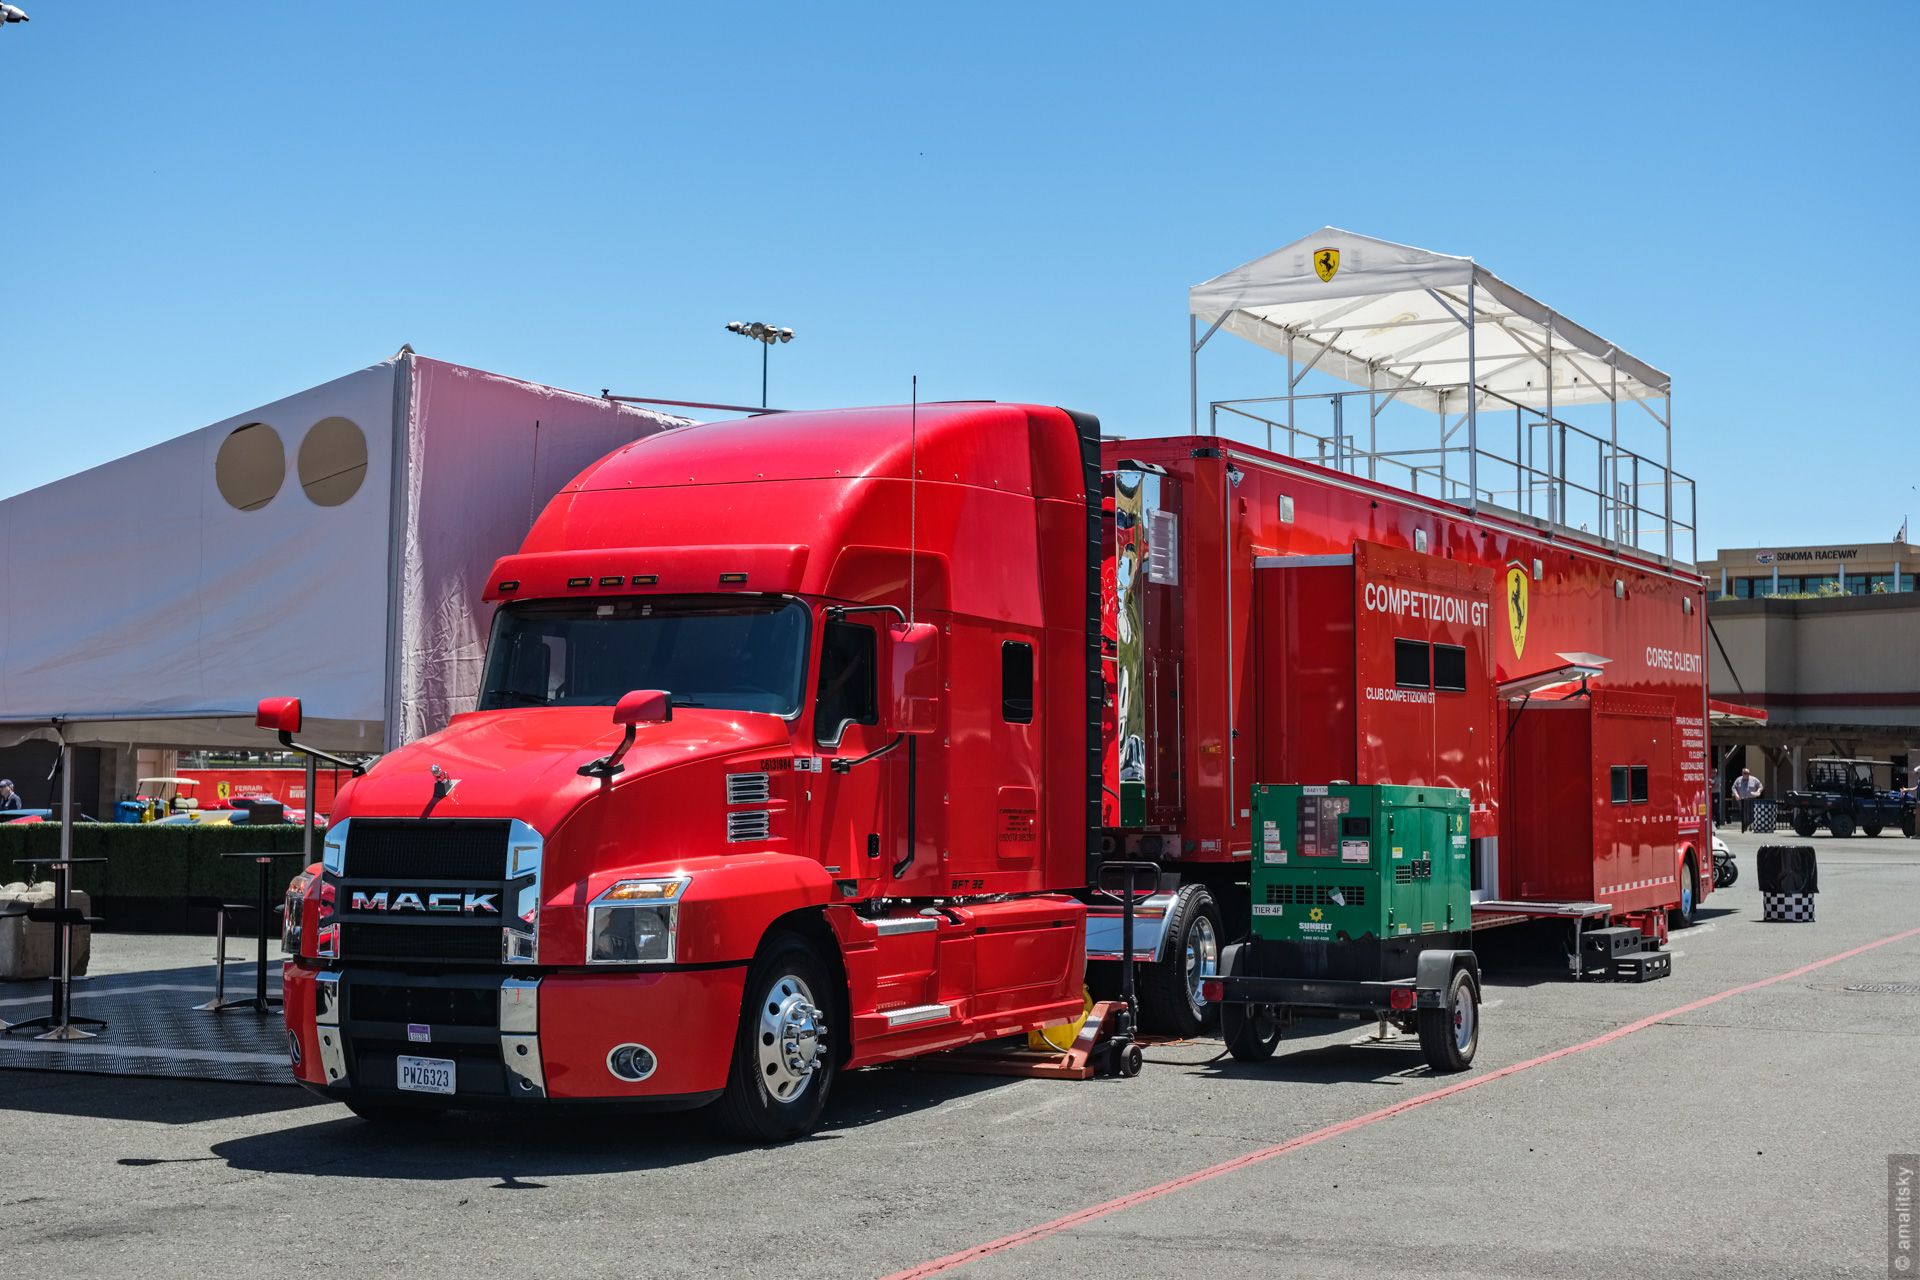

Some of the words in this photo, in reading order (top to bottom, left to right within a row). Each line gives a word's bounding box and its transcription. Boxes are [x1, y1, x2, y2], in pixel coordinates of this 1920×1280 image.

[1777, 551, 1813, 561] SONOMA
[1815, 549, 1858, 560] RACEWAY
[1365, 582, 1468, 625] COMPETIZIONI
[1471, 601, 1489, 627] GT
[1646, 646, 1673, 669] CORSE
[1674, 651, 1702, 673] CLIENTI
[1366, 687, 1384, 701] CLUB
[1385, 689, 1428, 704] COMPETIZIONI
[1428, 692, 1436, 704] GT
[951, 879, 970, 890] BFT
[971, 879, 984, 890] 32
[352, 891, 499, 913] MACK
[1254, 906, 1270, 914] TIER
[1272, 906, 1281, 914] 4F
[1299, 922, 1332, 931] SUNBELT
[403, 1066, 449, 1087] PWZ6323
